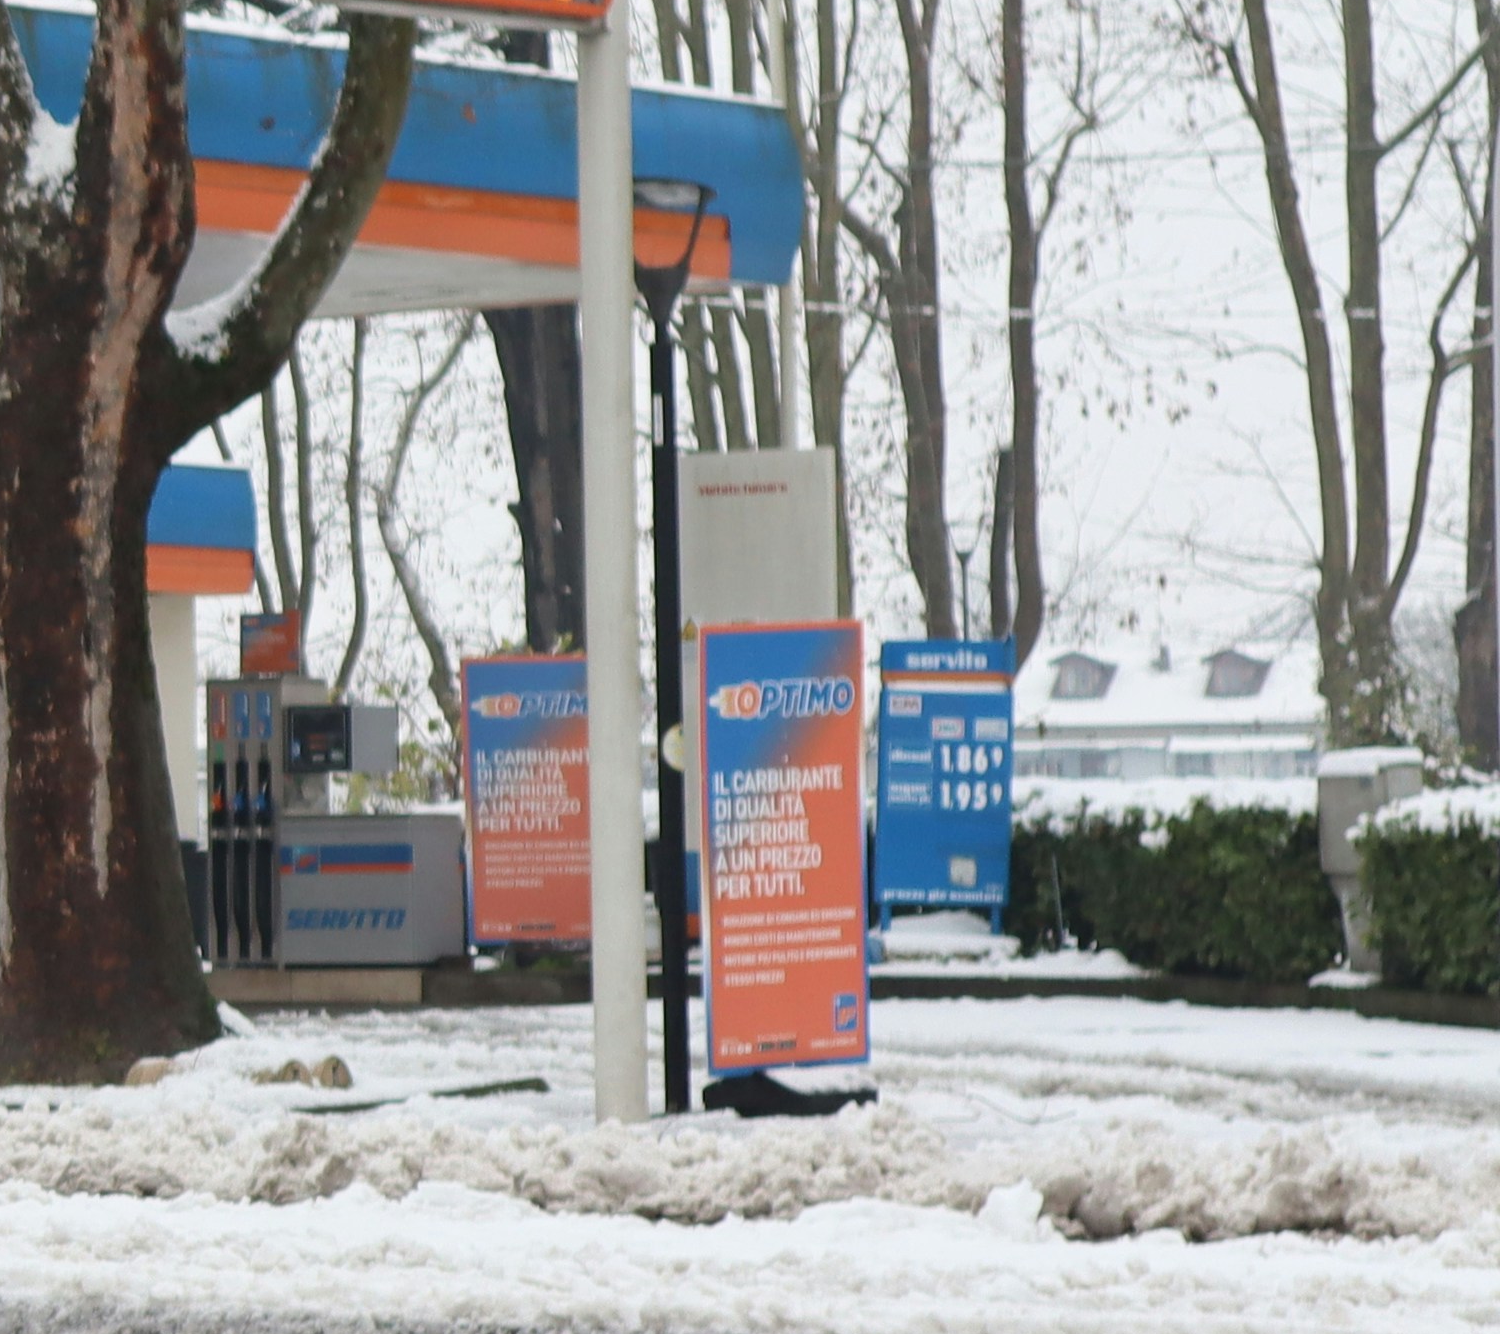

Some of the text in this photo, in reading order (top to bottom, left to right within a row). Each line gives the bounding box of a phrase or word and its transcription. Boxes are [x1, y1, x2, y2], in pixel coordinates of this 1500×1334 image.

[906, 649, 988, 670] servito
[498, 690, 588, 720] OPTIM
[737, 675, 855, 720] OPTIMO
[477, 782, 568, 799] SUPERIORE
[714, 764, 844, 795] IL CARBURANTE
[520, 797, 582, 815] PREZZO
[715, 796, 732, 821] DI
[479, 817, 511, 833] PER
[714, 818, 810, 848] SUPERIORE
[716, 843, 822, 874] A UN PREZZO
[717, 874, 751, 900] PER
[286, 909, 407, 930] SERVITO
